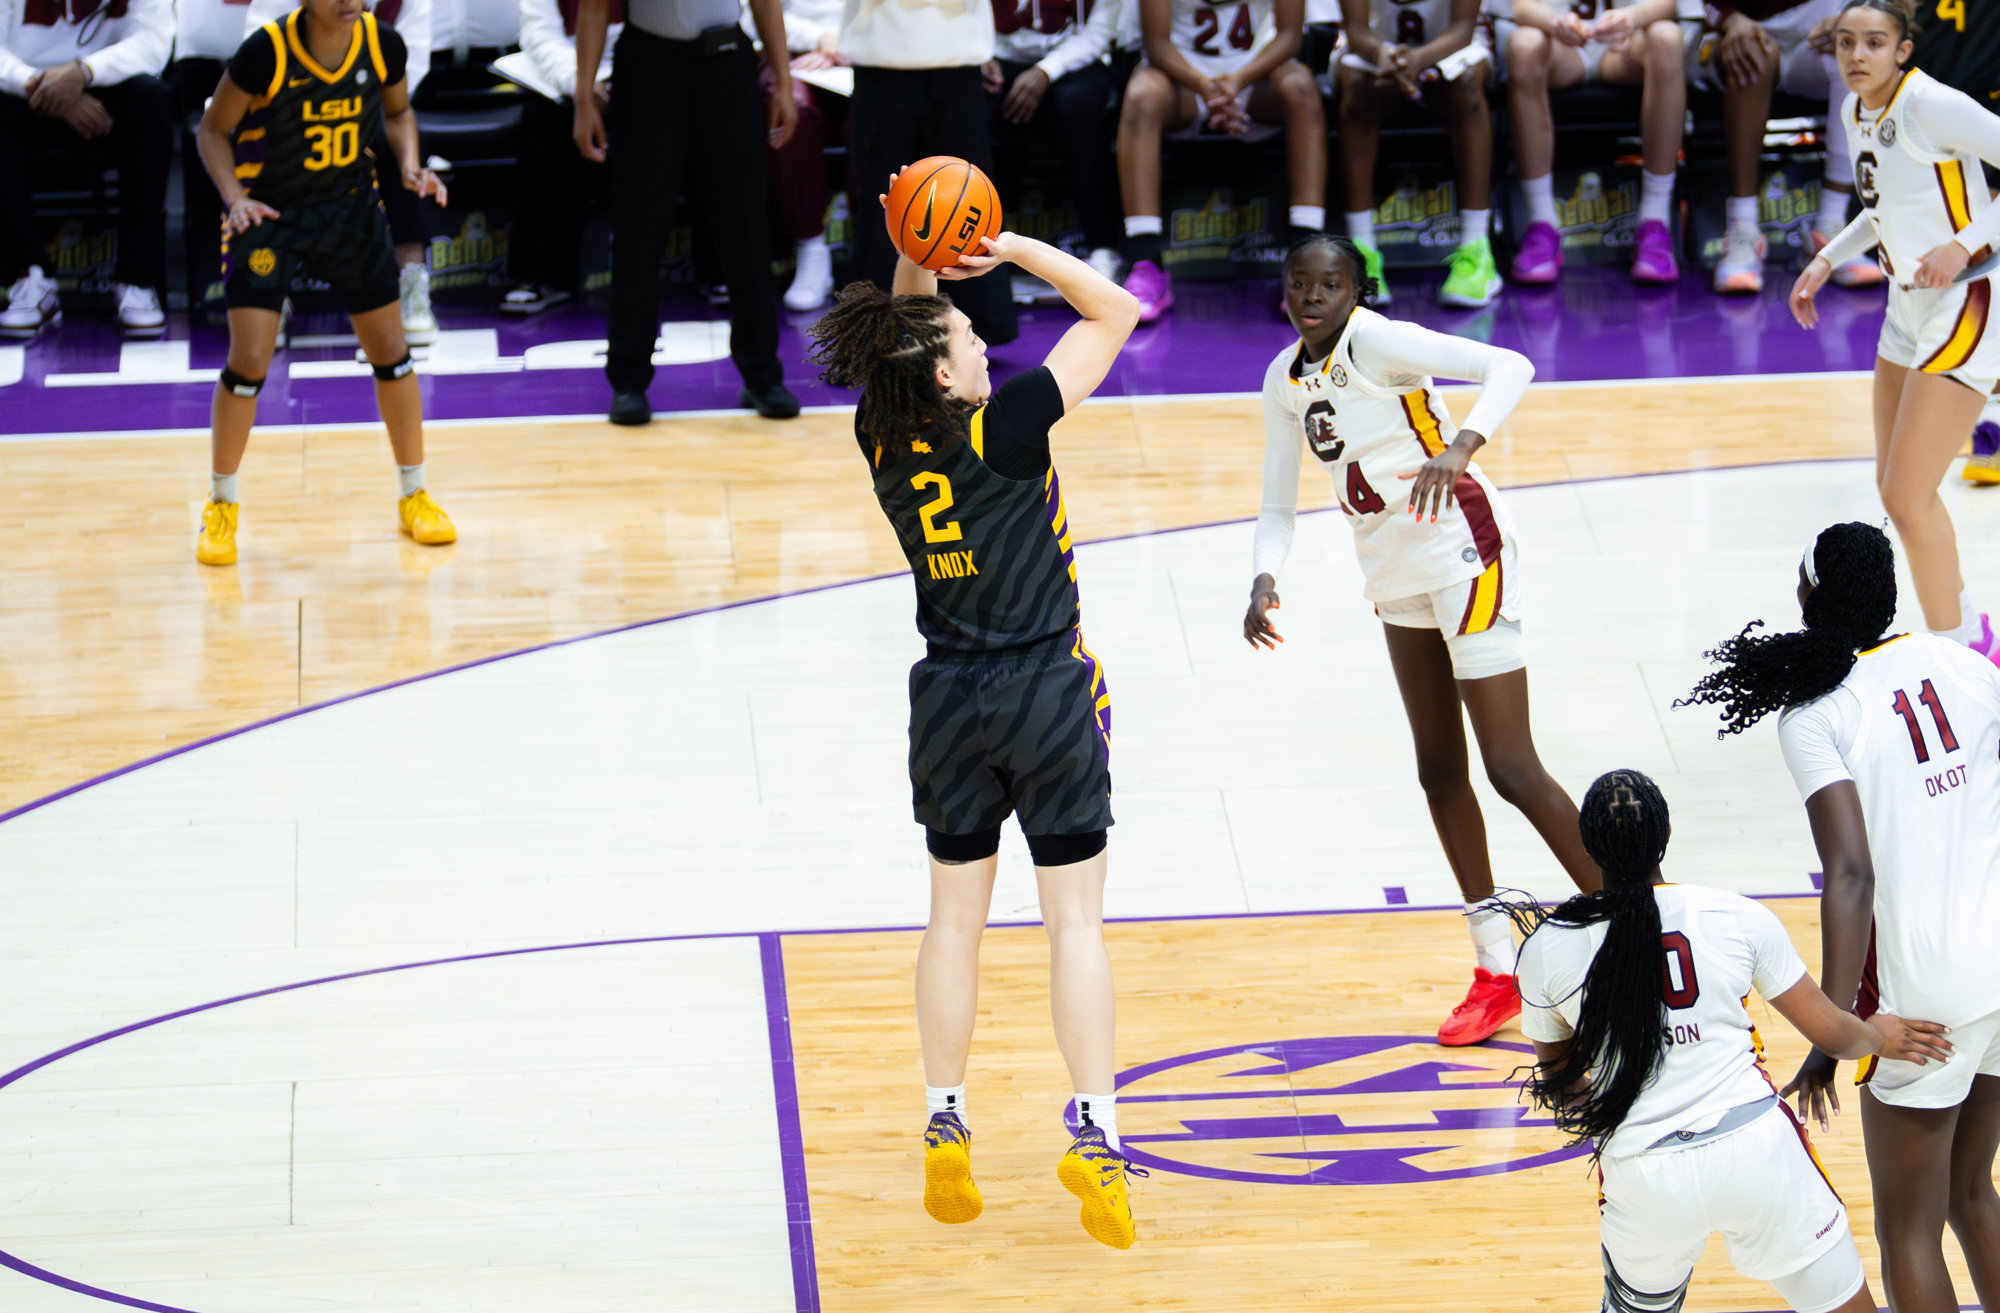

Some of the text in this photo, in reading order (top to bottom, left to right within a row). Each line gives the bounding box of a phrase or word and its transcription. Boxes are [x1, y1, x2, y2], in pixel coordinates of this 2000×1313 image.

[1194, 2, 1254, 55] 24
[303, 96, 362, 121] LSU
[303, 121, 359, 171] 30
[949, 205, 982, 254] LSU
[910, 470, 963, 544] 2
[926, 550, 979, 580] KNOX
[1891, 678, 1960, 765] 11
[1924, 764, 1967, 798] OKOT
